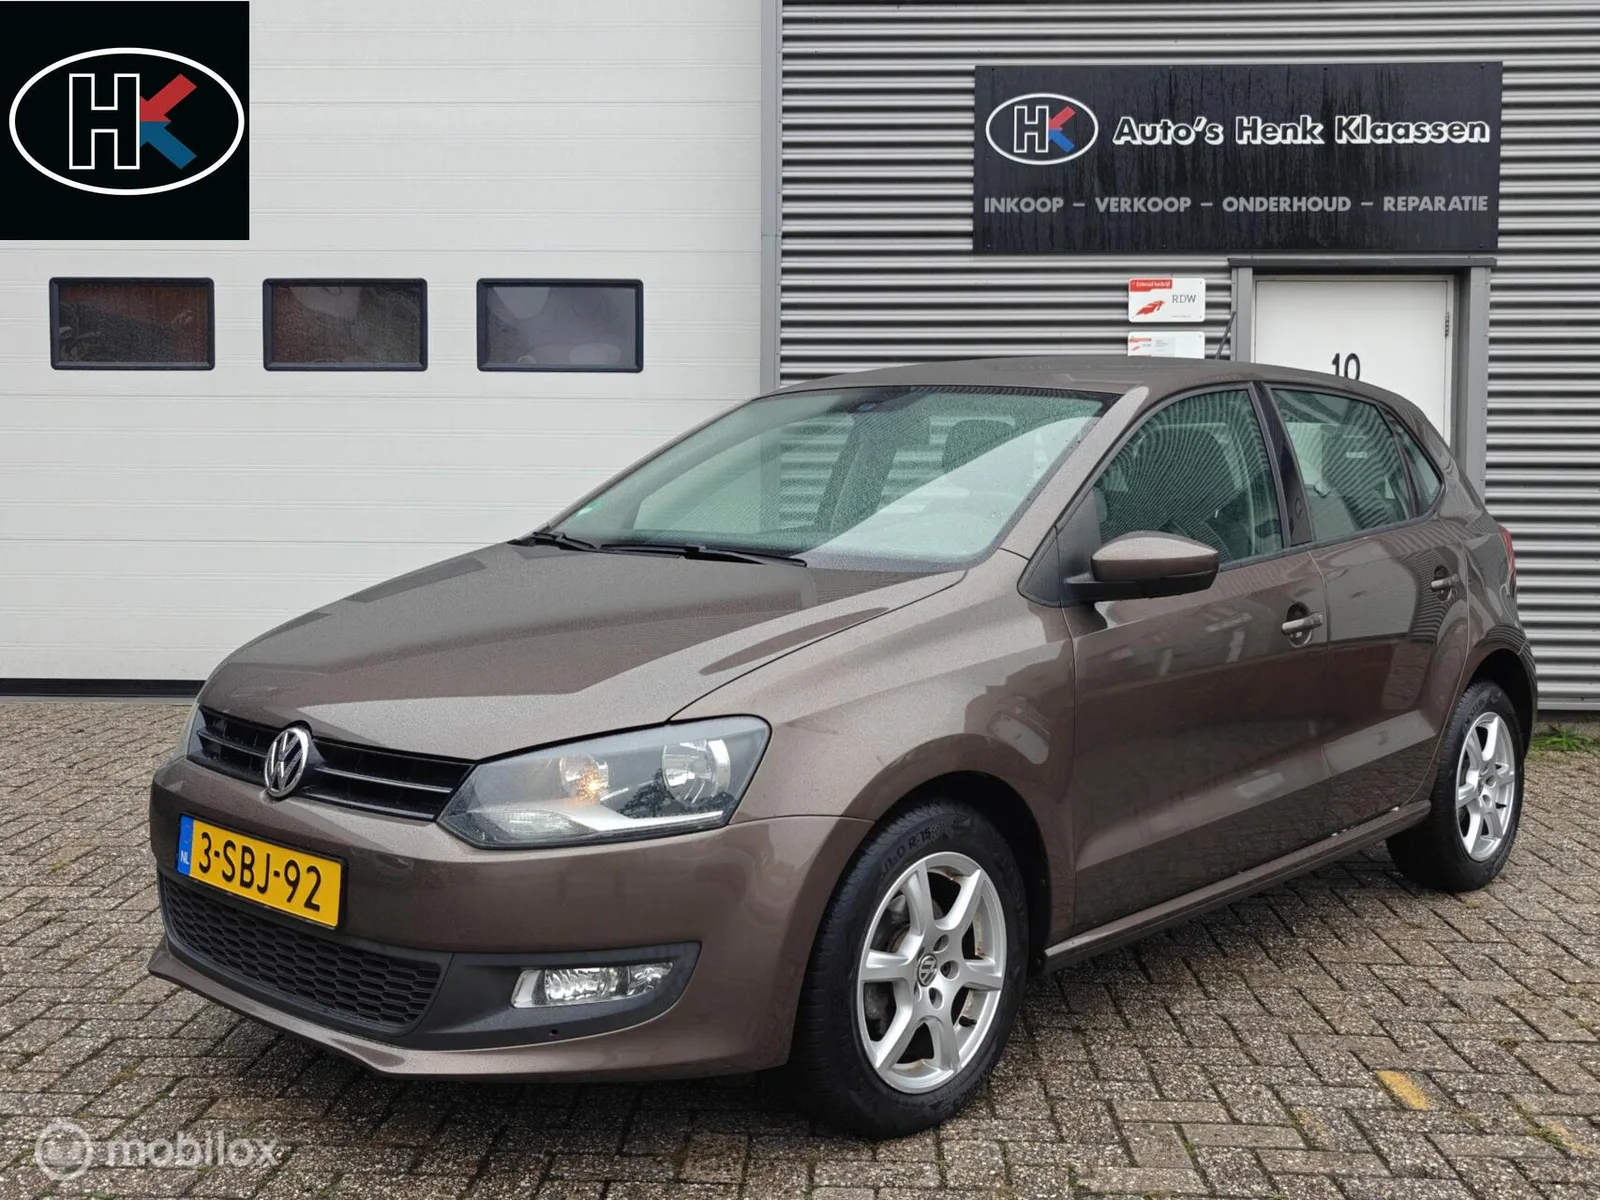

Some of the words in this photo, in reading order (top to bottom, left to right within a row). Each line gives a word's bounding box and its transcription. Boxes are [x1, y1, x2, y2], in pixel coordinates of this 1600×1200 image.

[1112, 115, 1224, 146] Auto's
[1235, 114, 1325, 146] Henk
[1334, 113, 1491, 145] Klaassen
[984, 196, 1064, 213] INKOOP
[1094, 196, 1192, 213] VERKOOP
[1222, 196, 1352, 213] ONDERHOUD
[1383, 195, 1489, 212] REPARATIE
[1172, 294, 1197, 304] RDW
[1332, 353, 1360, 380] 10
[180, 850, 190, 865] NL
[199, 831, 321, 912] 3-SBJ-92
